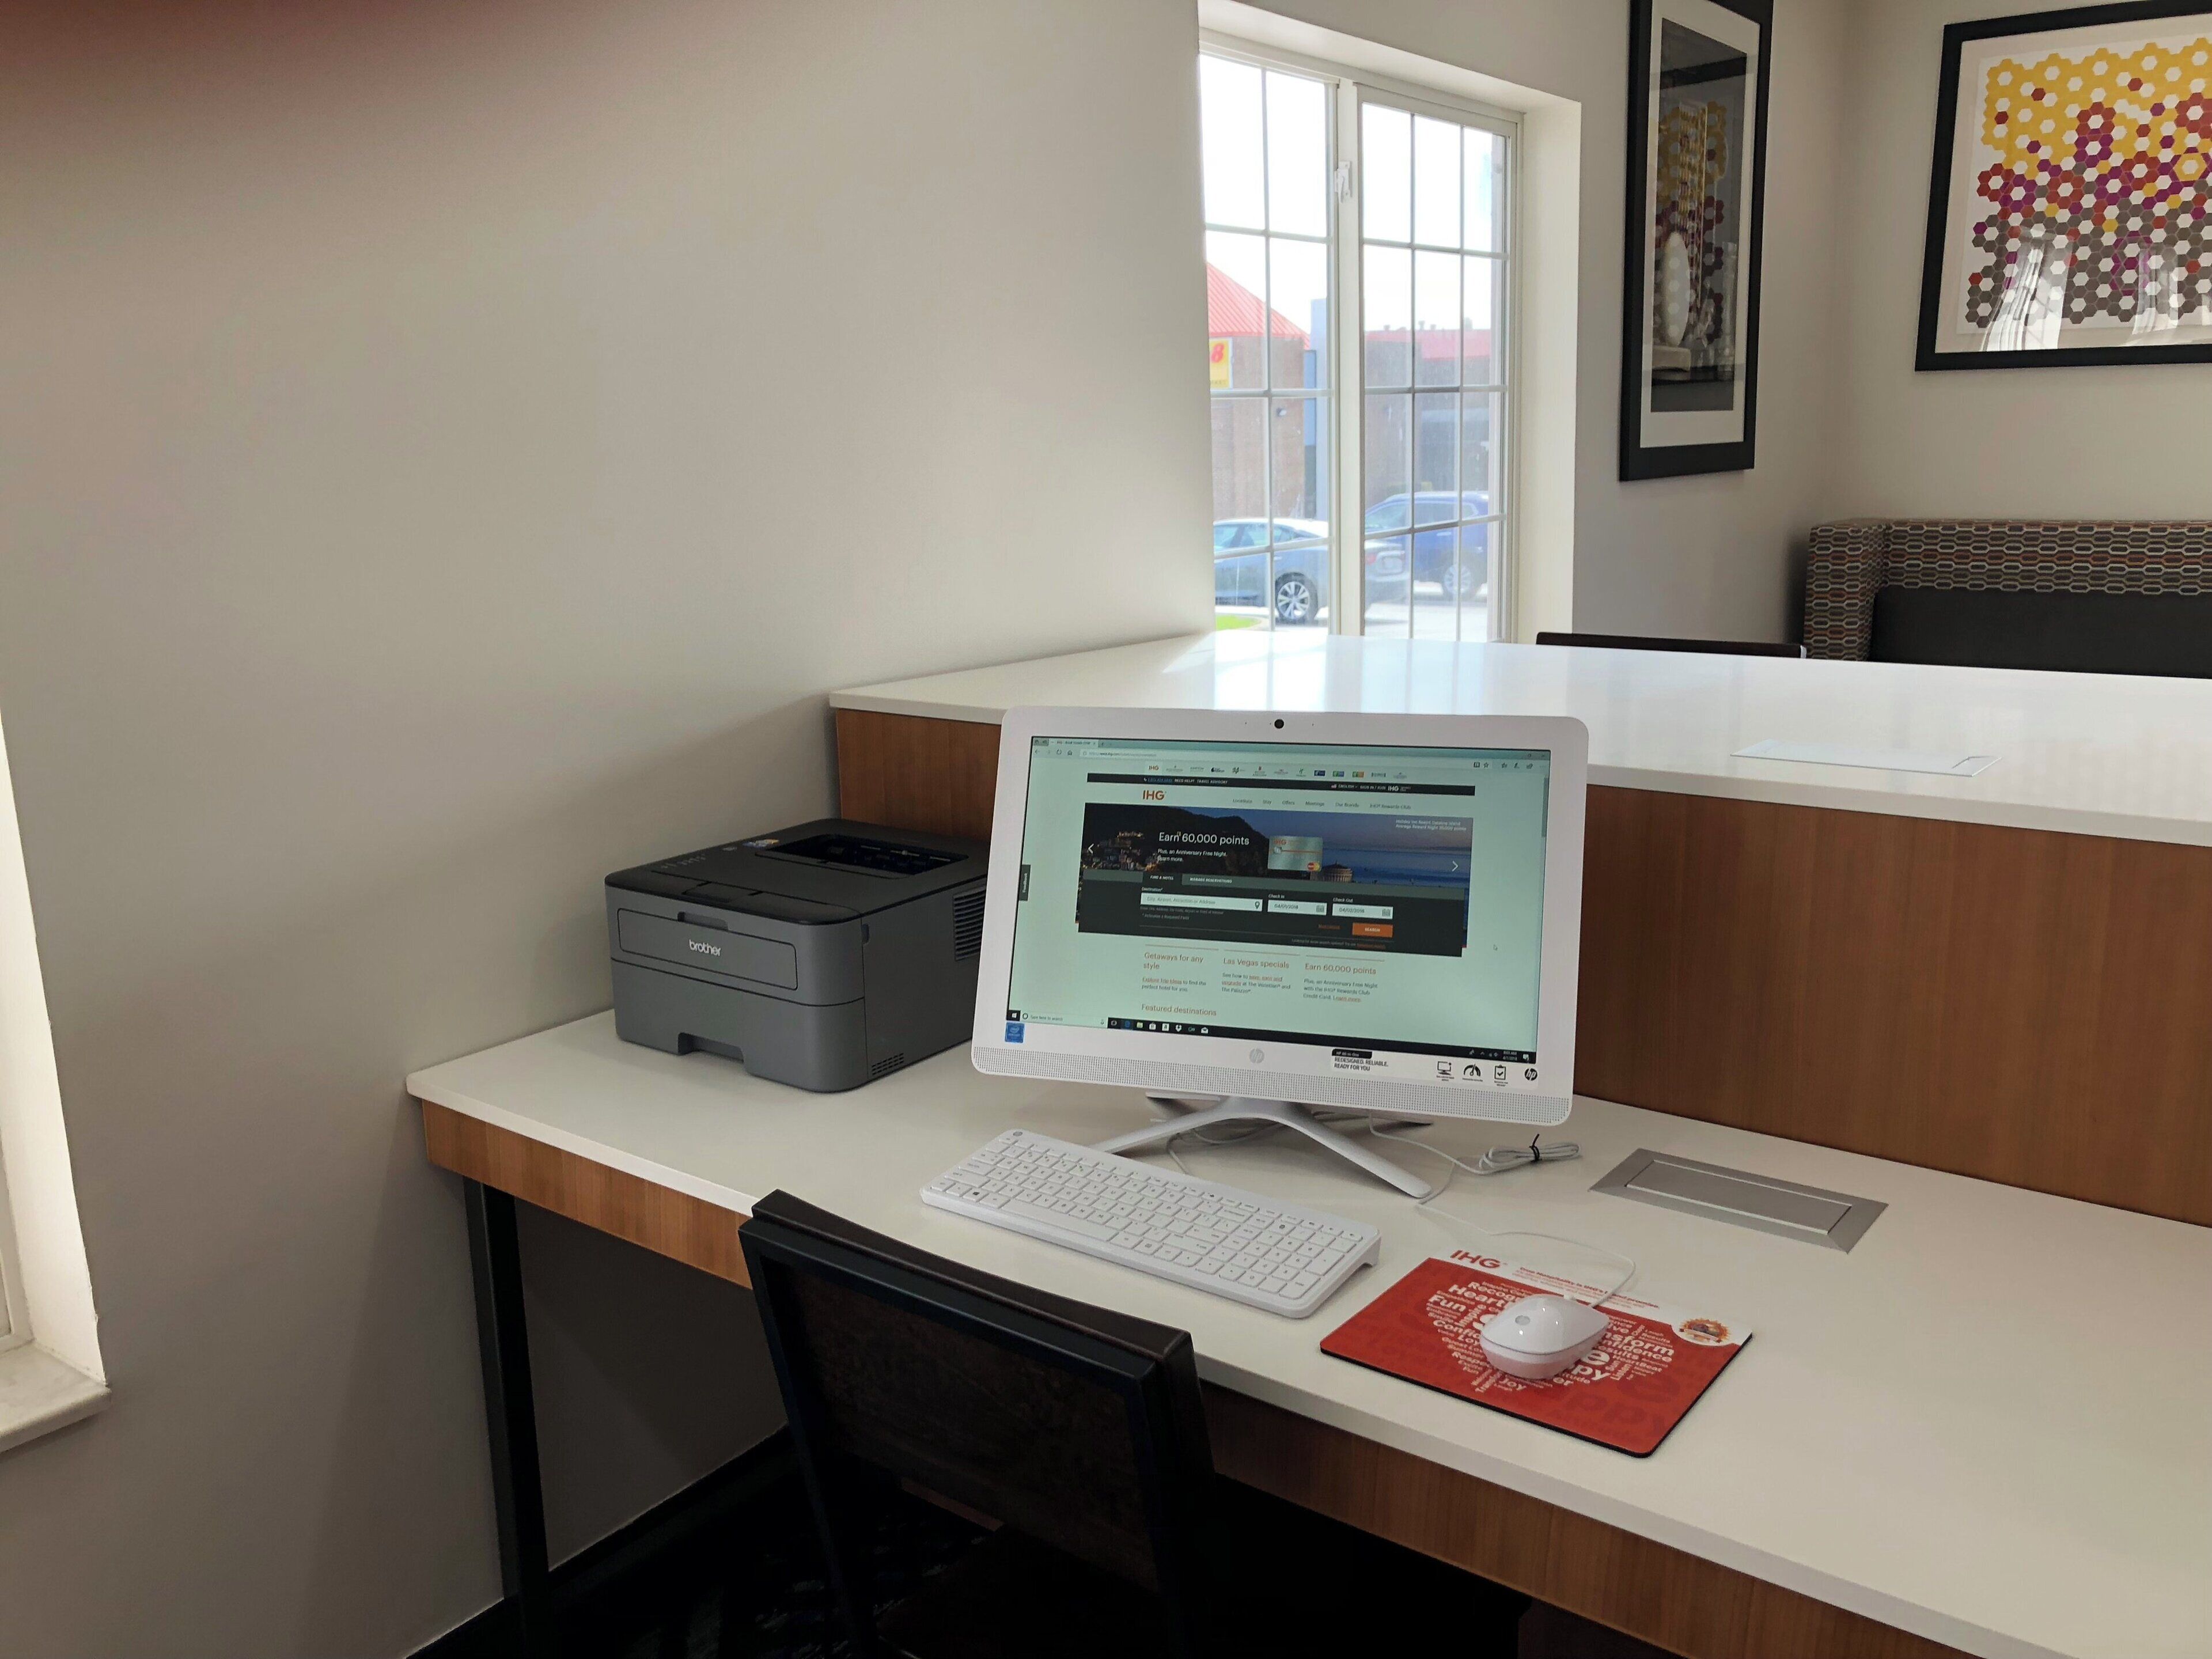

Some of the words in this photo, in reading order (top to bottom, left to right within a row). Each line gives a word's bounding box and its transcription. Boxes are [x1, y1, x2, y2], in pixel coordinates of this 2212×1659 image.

[1142, 790, 1165, 800] IHG
[1158, 832, 1179, 842] Earn
[1182, 833, 1217, 843] 60,000
[1219, 835, 1249, 846] points
[688, 939, 721, 956] brother
[1144, 952, 1178, 961] Getaways
[1237, 959, 1258, 967] Vegas
[1323, 964, 1351, 973] 60,000
[1353, 967, 1376, 975] points
[1141, 1004, 1172, 1012] Featured
[1173, 1006, 1217, 1016] destinations
[1450, 1249, 1501, 1268] IHG
[1428, 1294, 1467, 1312] Fun
[1499, 1378, 1527, 1391] Joy
